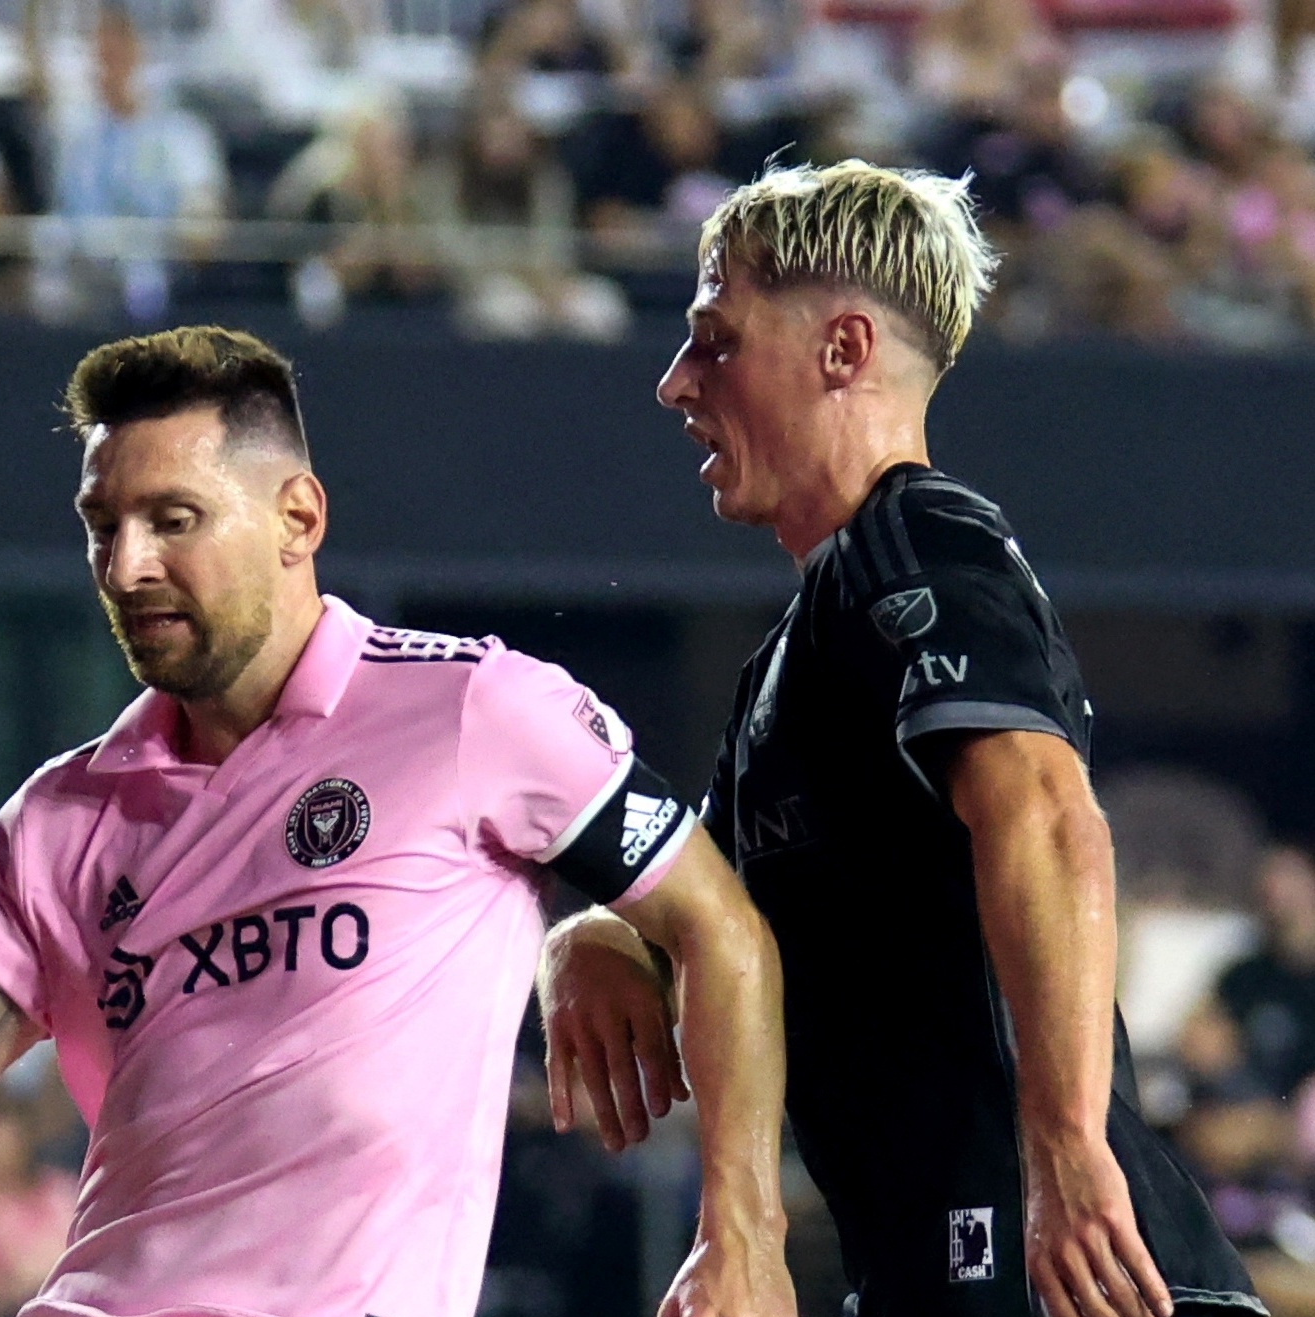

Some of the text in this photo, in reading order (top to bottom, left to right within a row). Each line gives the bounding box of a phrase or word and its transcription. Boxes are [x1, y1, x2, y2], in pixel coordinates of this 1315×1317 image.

[917, 650, 969, 685] tv
[622, 796, 679, 867] adidas
[179, 902, 371, 995] XBTO
[957, 1265, 987, 1280] CASH
